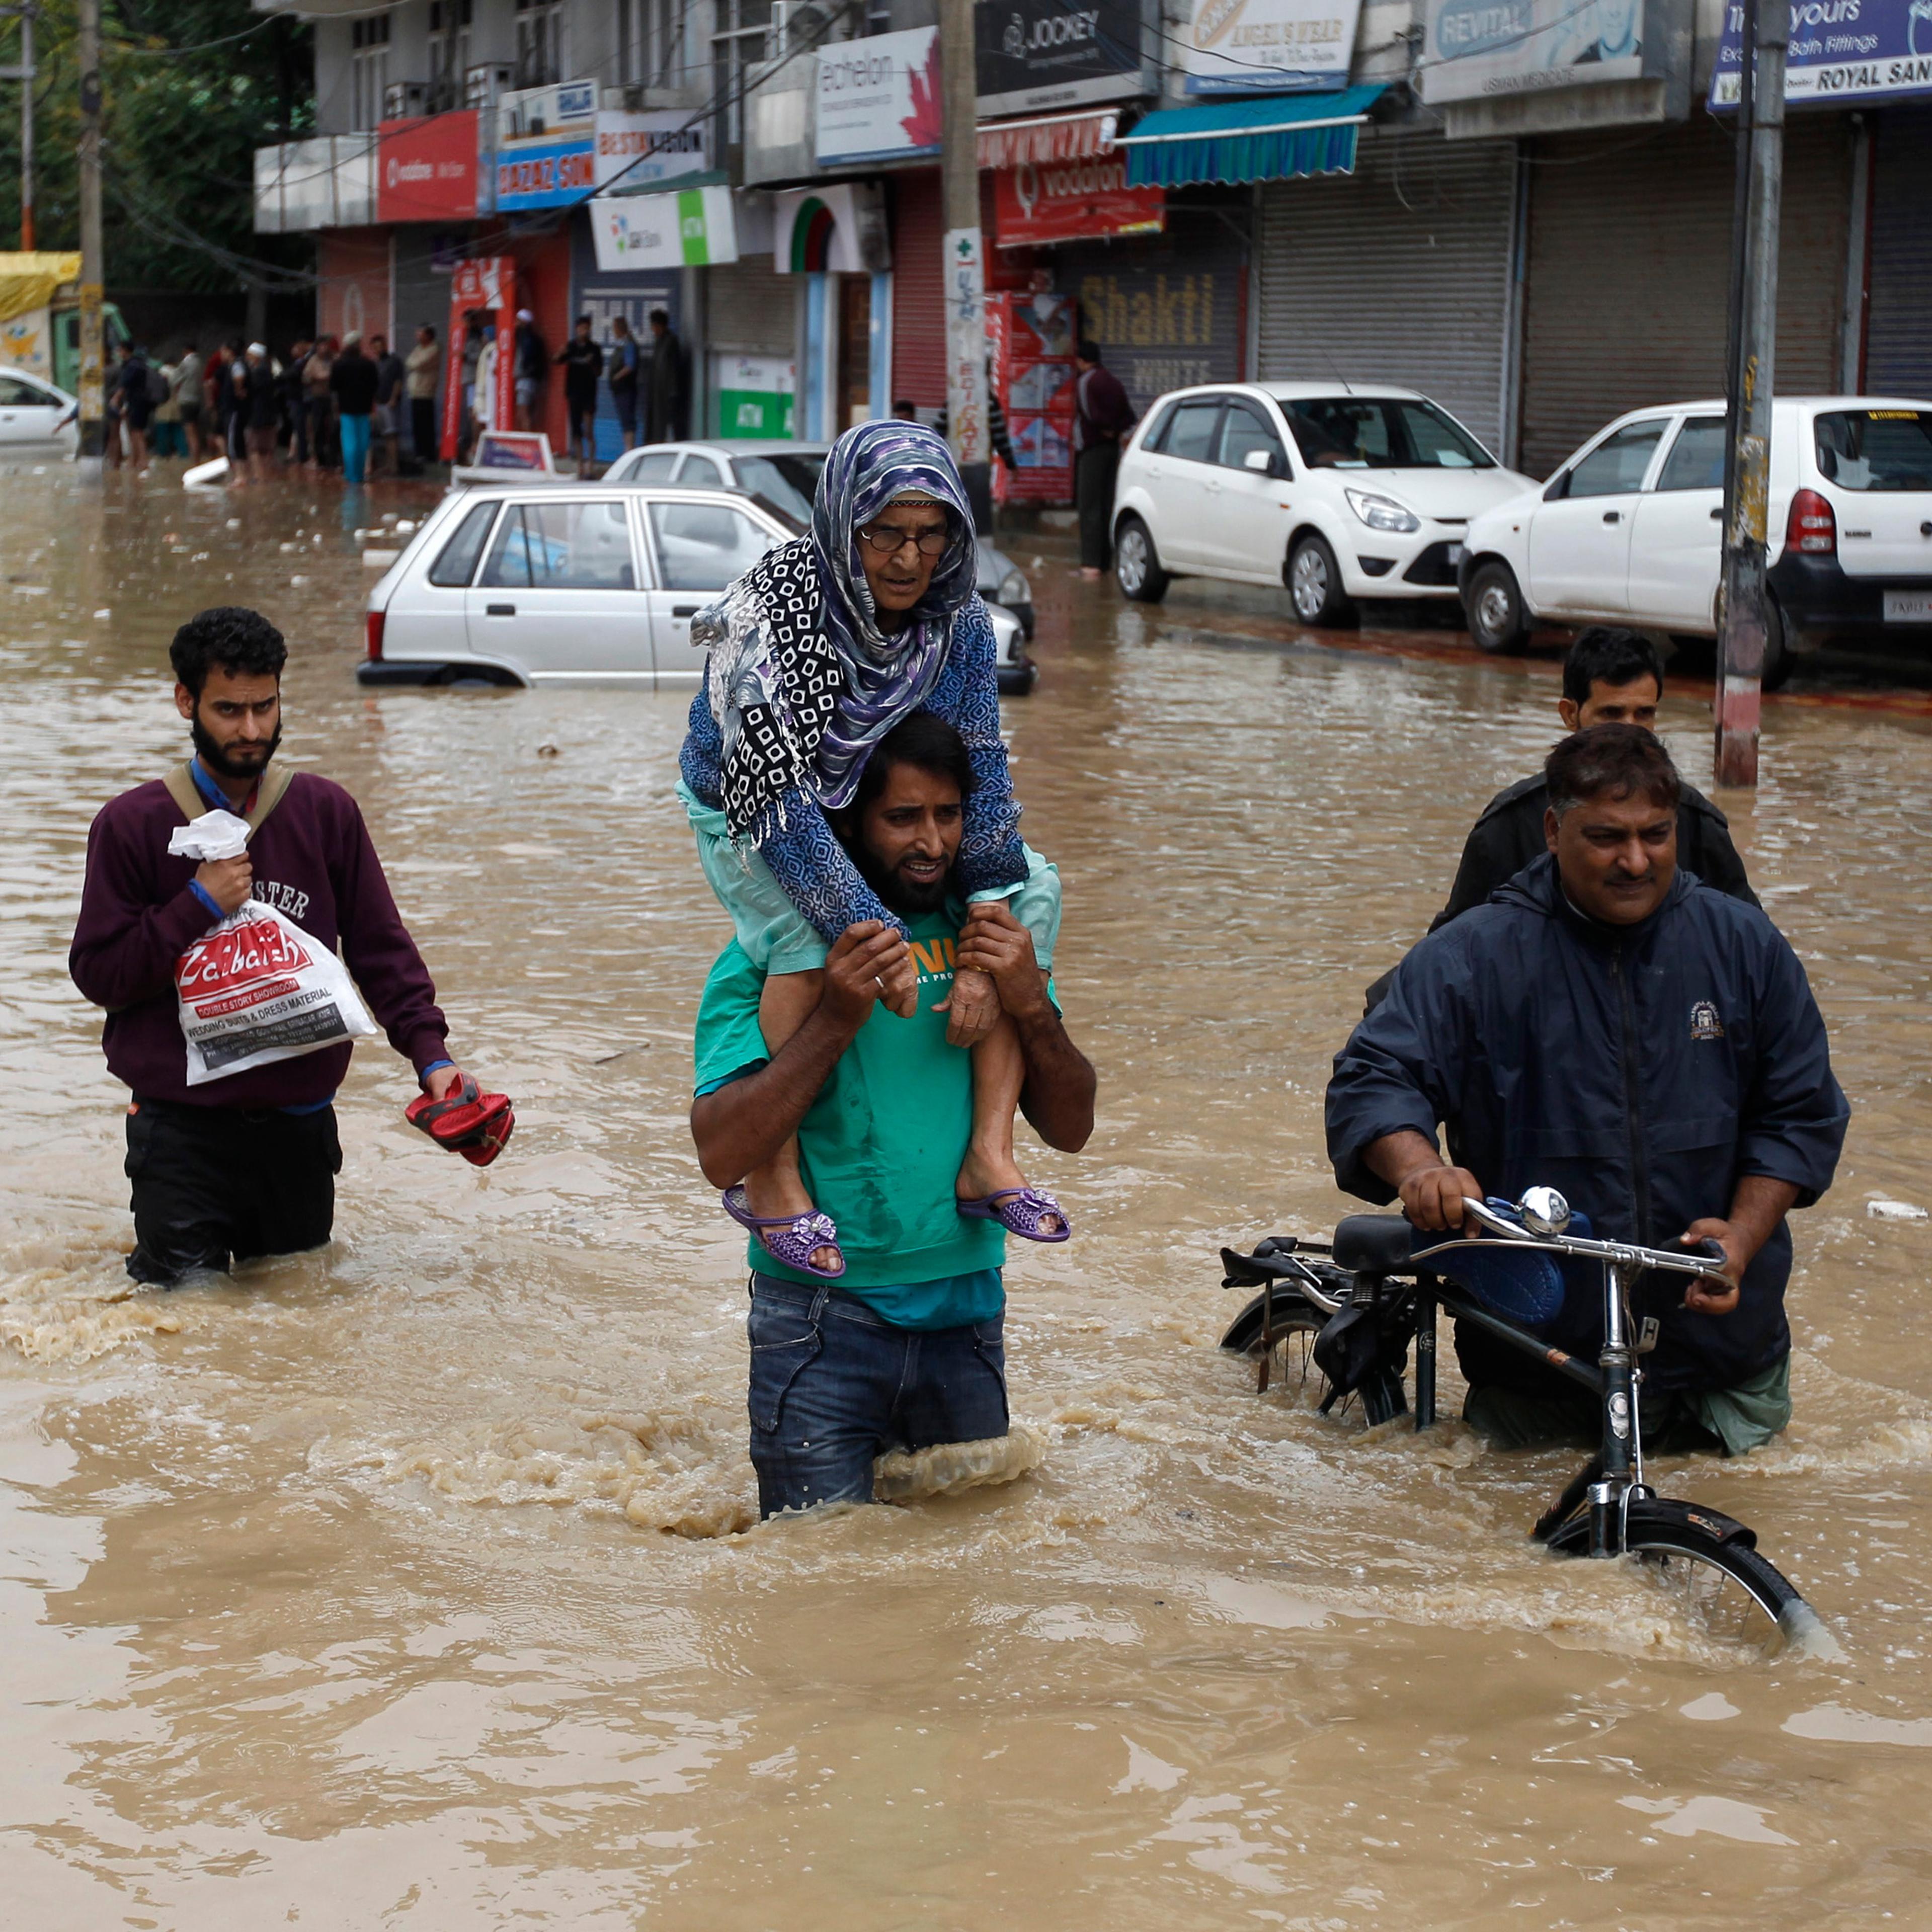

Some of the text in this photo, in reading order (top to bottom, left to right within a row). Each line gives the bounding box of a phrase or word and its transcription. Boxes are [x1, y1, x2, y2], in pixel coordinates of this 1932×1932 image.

[1026, 10, 1099, 49] JOCKEY
[1441, 5, 1526, 43] REVITAL
[1790, 0, 1861, 33] yours
[1789, 33, 1879, 56] Bath Fittings
[820, 50, 894, 92] echelon
[1818, 64, 1881, 91] ROYAL
[1081, 274, 1214, 345] Shakti
[736, 403, 764, 428] ATM
[186, 1020, 226, 1038] WEDDING
[227, 1014, 250, 1027] SUITS
[251, 1012, 258, 1022] &
[258, 1003, 288, 1020] DRESS
[288, 987, 332, 1007] MATERIAL
[198, 979, 299, 1017] DOUBLE STORY SHOWROOM
